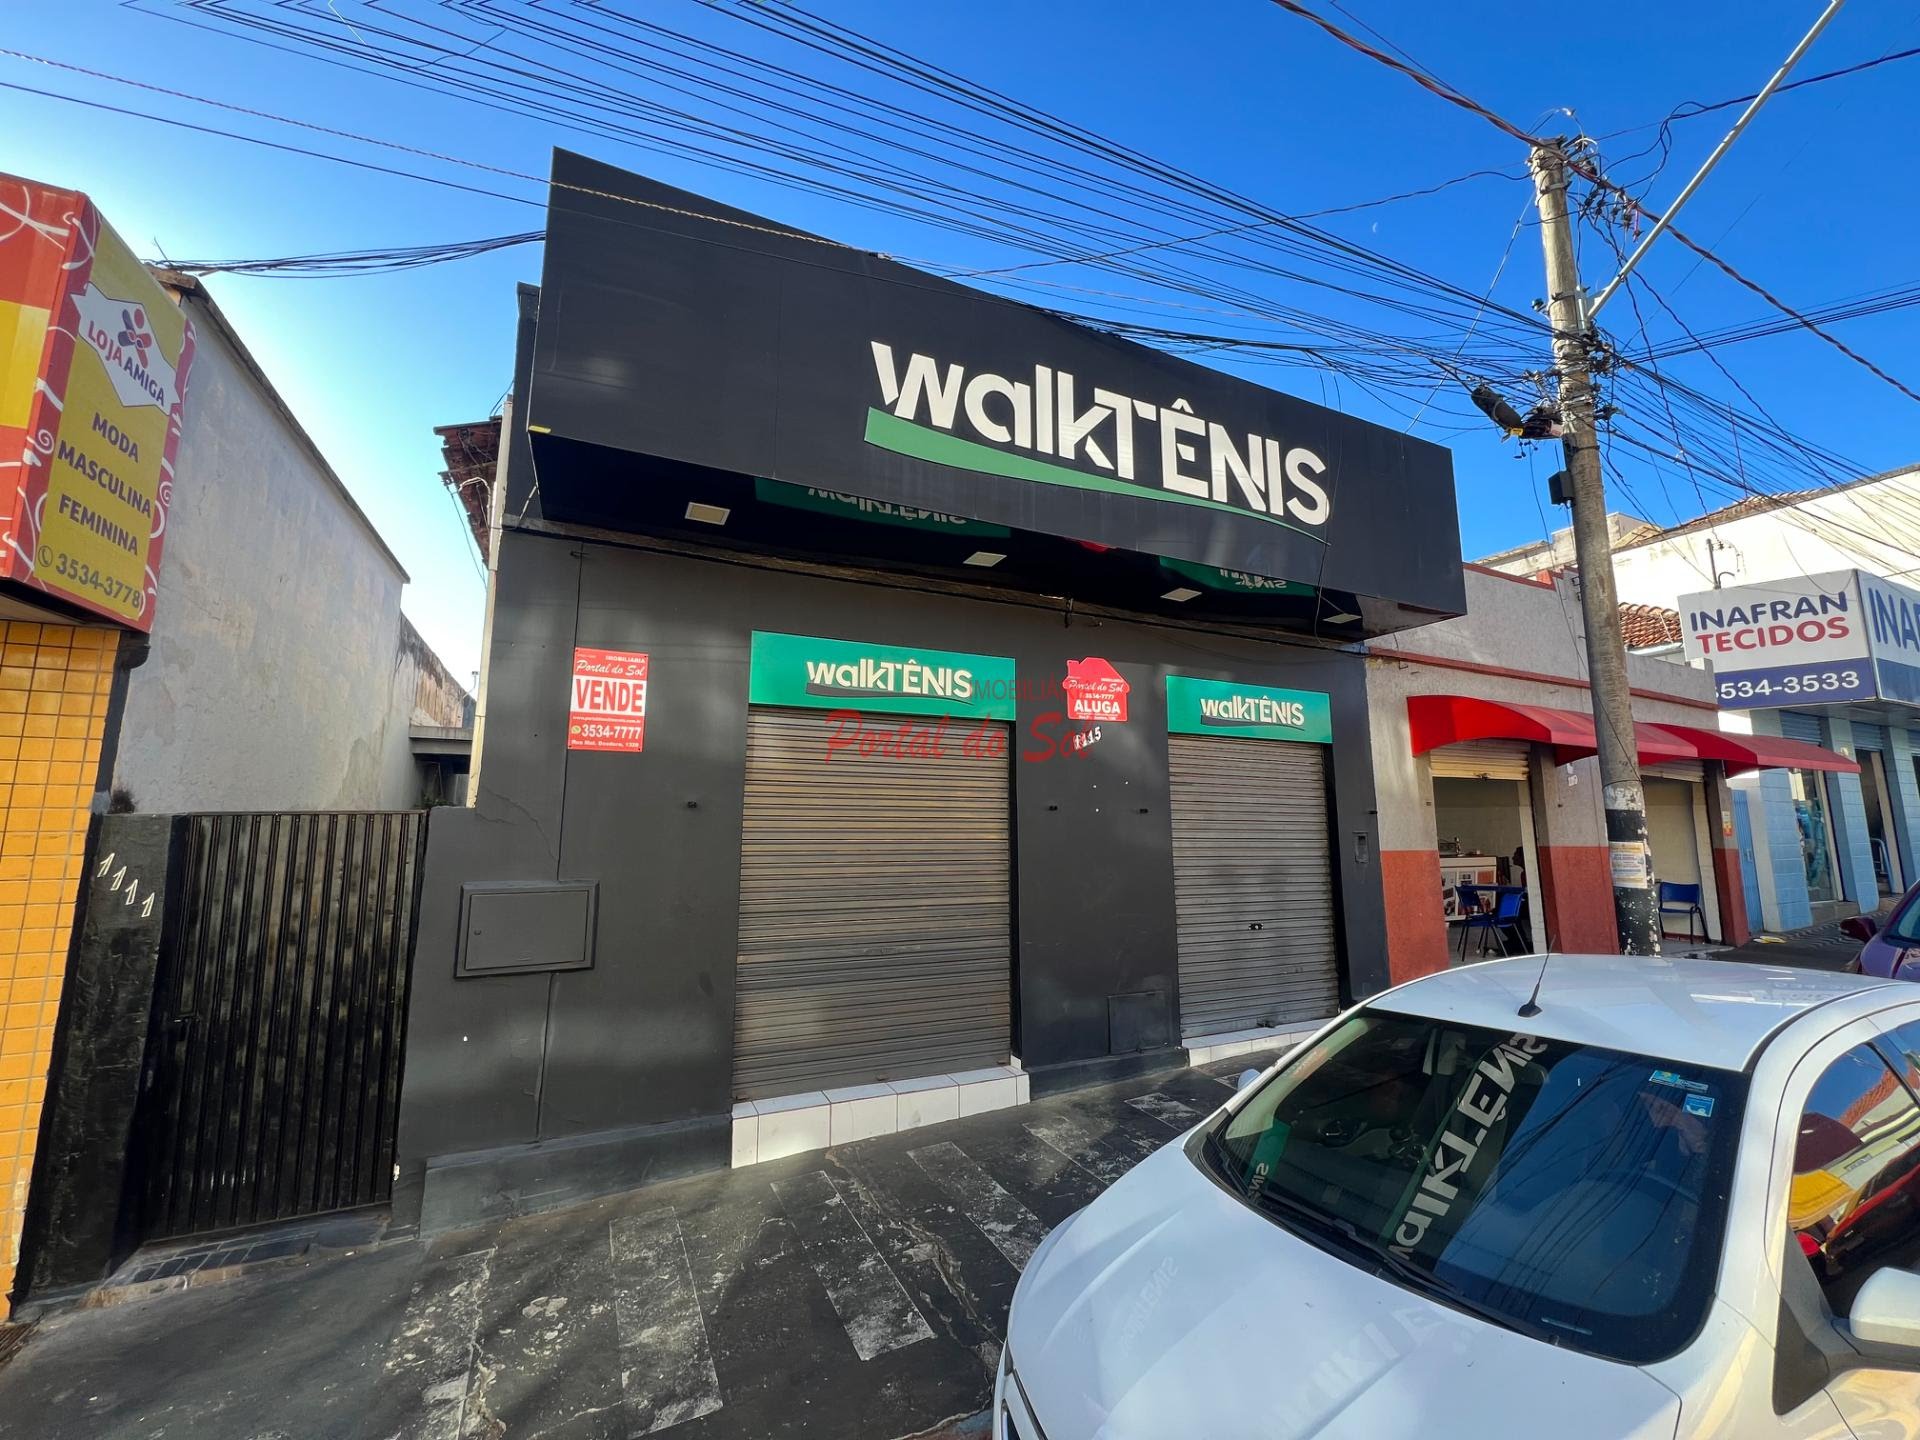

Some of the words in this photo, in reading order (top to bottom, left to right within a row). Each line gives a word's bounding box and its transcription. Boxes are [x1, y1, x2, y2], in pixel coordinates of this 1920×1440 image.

[88, 320, 122, 367] LOJA
[124, 356, 165, 407] AMIGA
[92, 412, 139, 463] MODA
[870, 340, 1331, 526] walkTÊNIS
[58, 440, 151, 519] MASCULINA
[59, 494, 138, 556] FEMININA
[56, 553, 141, 608] 3534-3778
[1690, 591, 1848, 631] INAFRAN
[1695, 616, 1850, 654] TECIDOS
[576, 659, 610, 674] Portal
[611, 664, 623, 674] do
[625, 665, 646, 676] Sol
[806, 658, 973, 699] walkTÊNIS
[1714, 671, 1860, 699] 534-3533
[576, 678, 644, 713] VENDE
[1074, 699, 1121, 714] ALUGA
[1200, 695, 1305, 726] walkTÊNIS
[581, 723, 641, 739] 3534-7777
[97, 852, 155, 918] 1111
